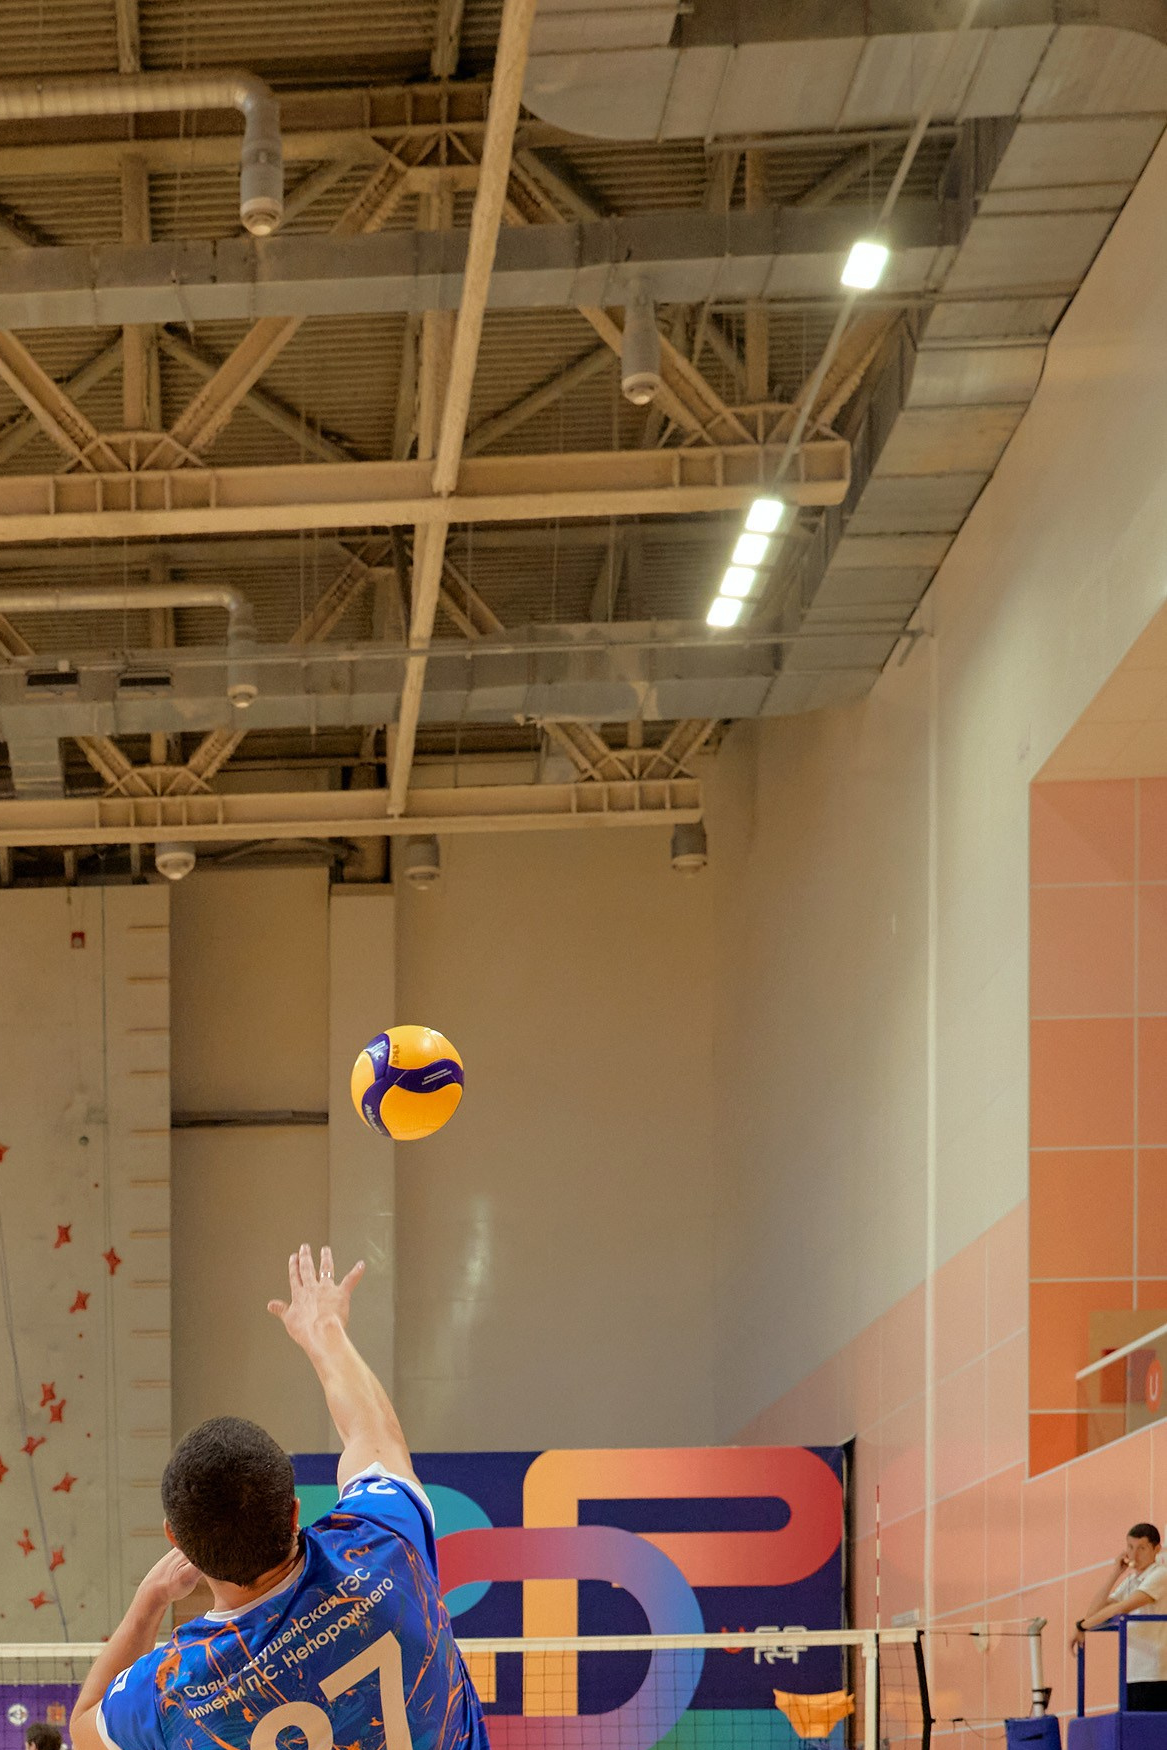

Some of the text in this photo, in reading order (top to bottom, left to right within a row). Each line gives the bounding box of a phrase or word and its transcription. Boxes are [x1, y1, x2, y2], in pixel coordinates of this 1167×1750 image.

[184, 1592, 340, 1698] Саянушенская
[336, 1567, 371, 1598] ГЭС
[189, 1577, 394, 1720] имени П.С. Непорожнего
